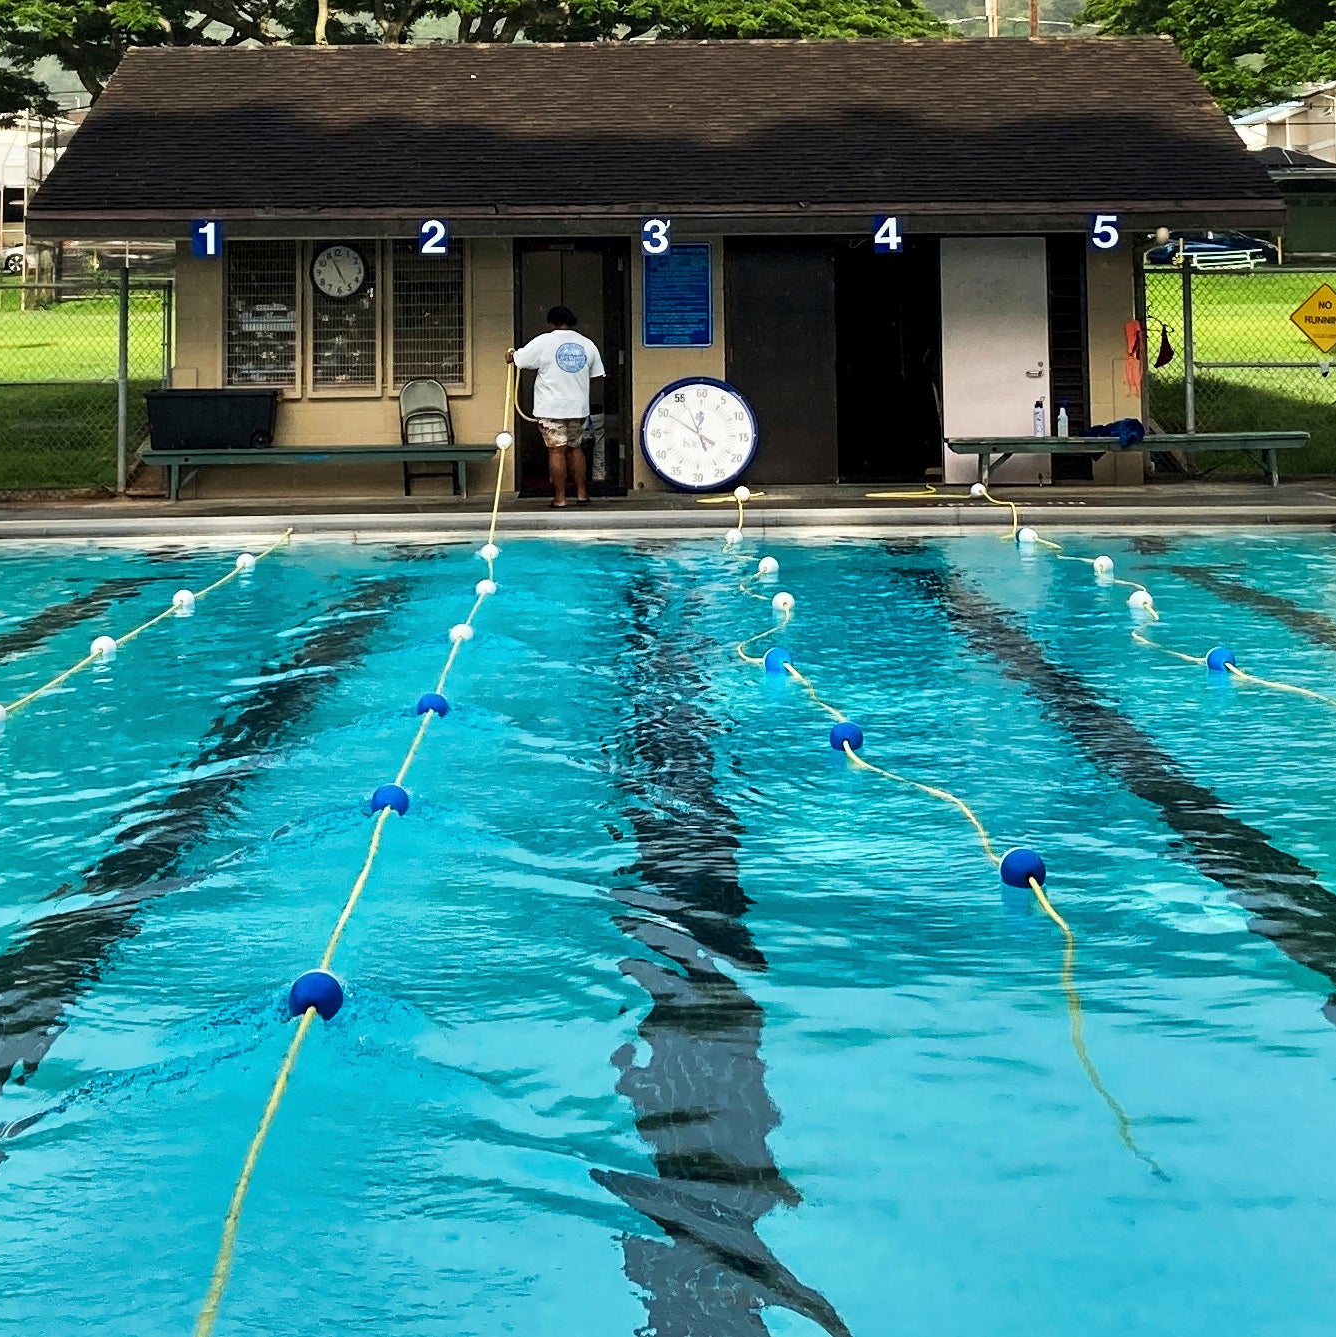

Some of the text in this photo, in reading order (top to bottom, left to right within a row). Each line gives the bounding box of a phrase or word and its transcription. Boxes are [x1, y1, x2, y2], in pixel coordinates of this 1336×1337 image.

[421, 219, 446, 253] 2
[642, 219, 669, 254] 3
[874, 217, 902, 250] 4
[1092, 215, 1119, 248] 5
[198, 222, 215, 254] 1
[334, 248, 342, 257] 12
[320, 278, 326, 286] 8
[347, 283, 352, 291] 5
[337, 286, 343, 294] 6
[1317, 301, 1332, 310] NO
[674, 393, 686, 403] 55
[696, 389, 708, 398] 60
[720, 395, 727, 405] 5
[657, 408, 669, 418] 50
[733, 411, 744, 421] 10
[650, 429, 662, 438] 45
[739, 433, 749, 442] 15
[655, 450, 667, 460] 40
[731, 453, 743, 463] 20
[670, 466, 682, 476] 35
[714, 468, 726, 478] 25
[692, 473, 704, 482] 30
